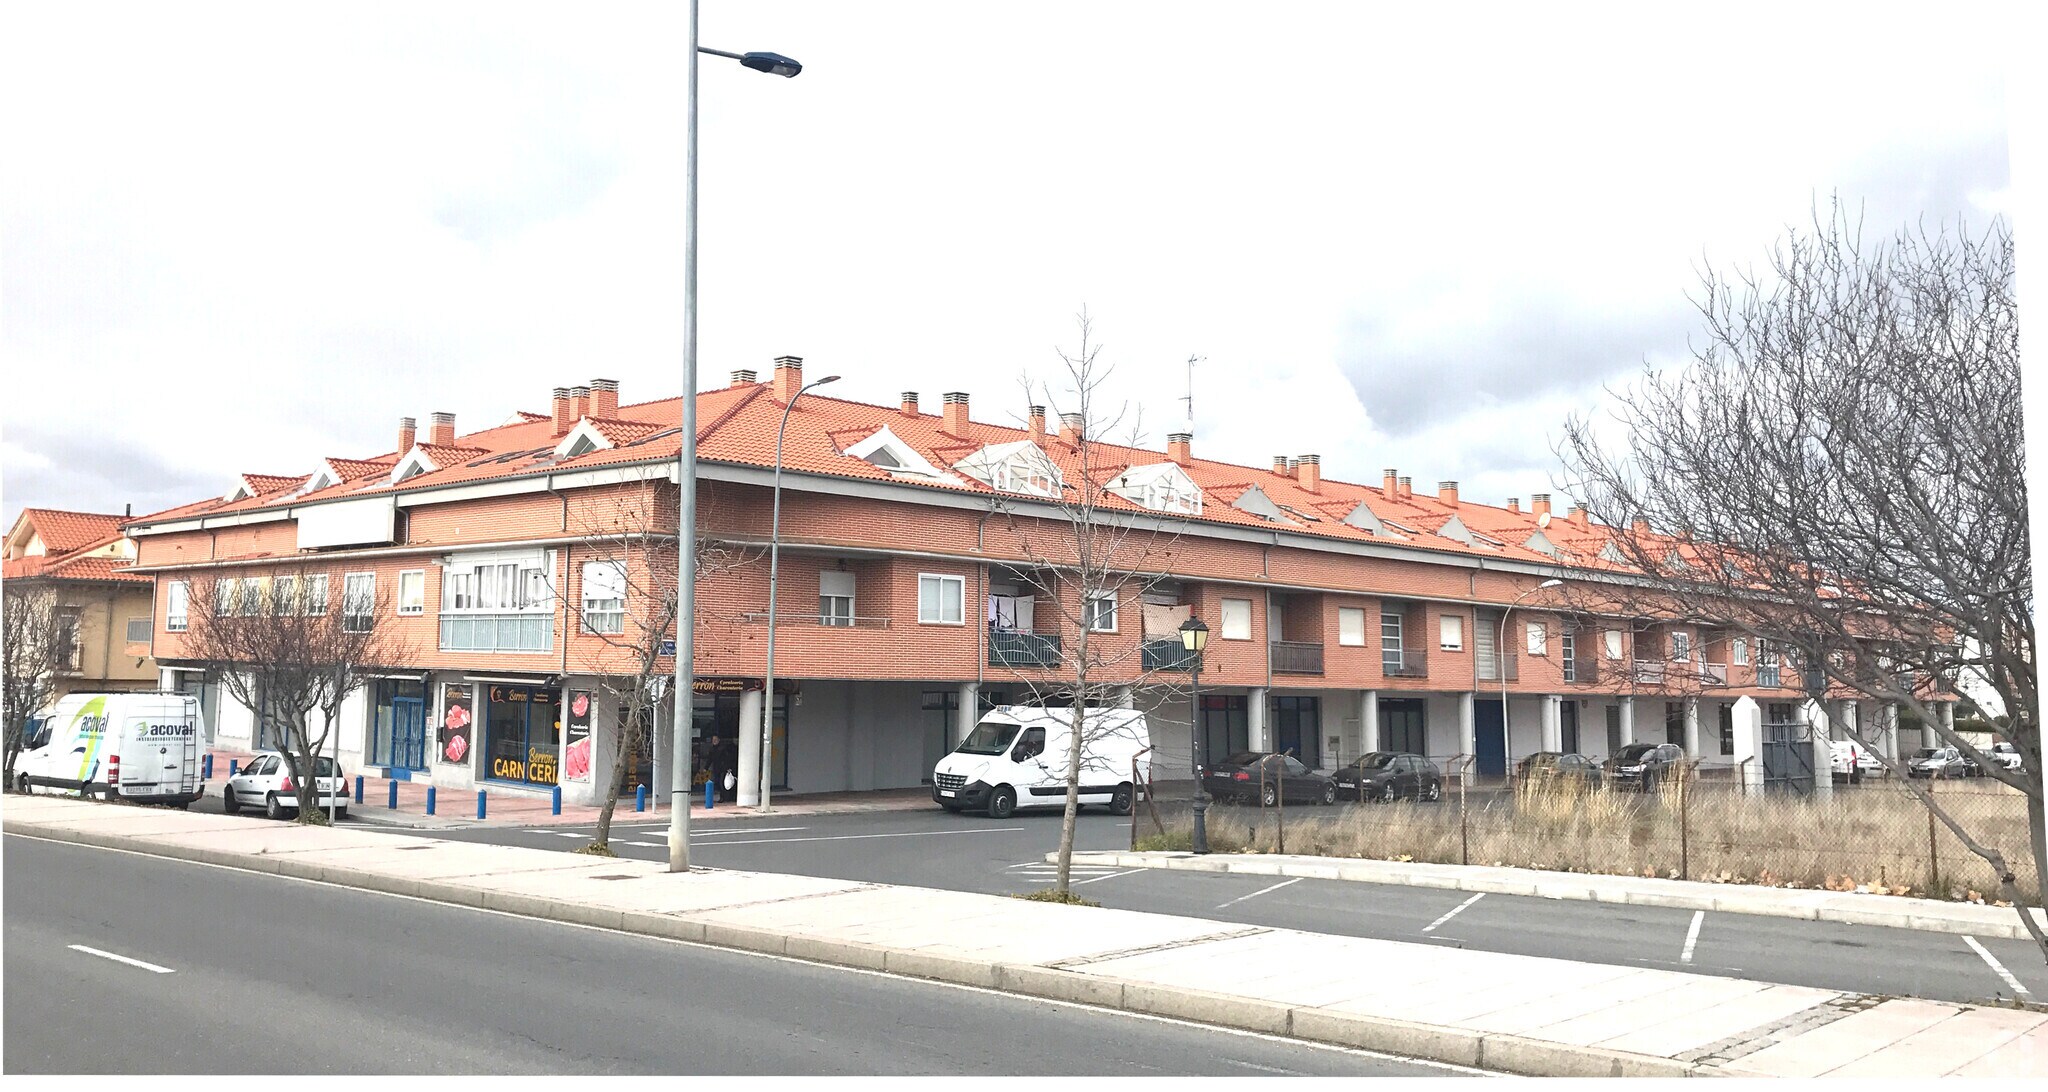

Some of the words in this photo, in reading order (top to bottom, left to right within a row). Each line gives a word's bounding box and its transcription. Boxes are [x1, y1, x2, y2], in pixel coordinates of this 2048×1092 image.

[691, 678, 715, 691] errón
[80, 711, 109, 733] acoval
[150, 721, 193, 735] acoval
[494, 758, 560, 784] CARNCERÍ
